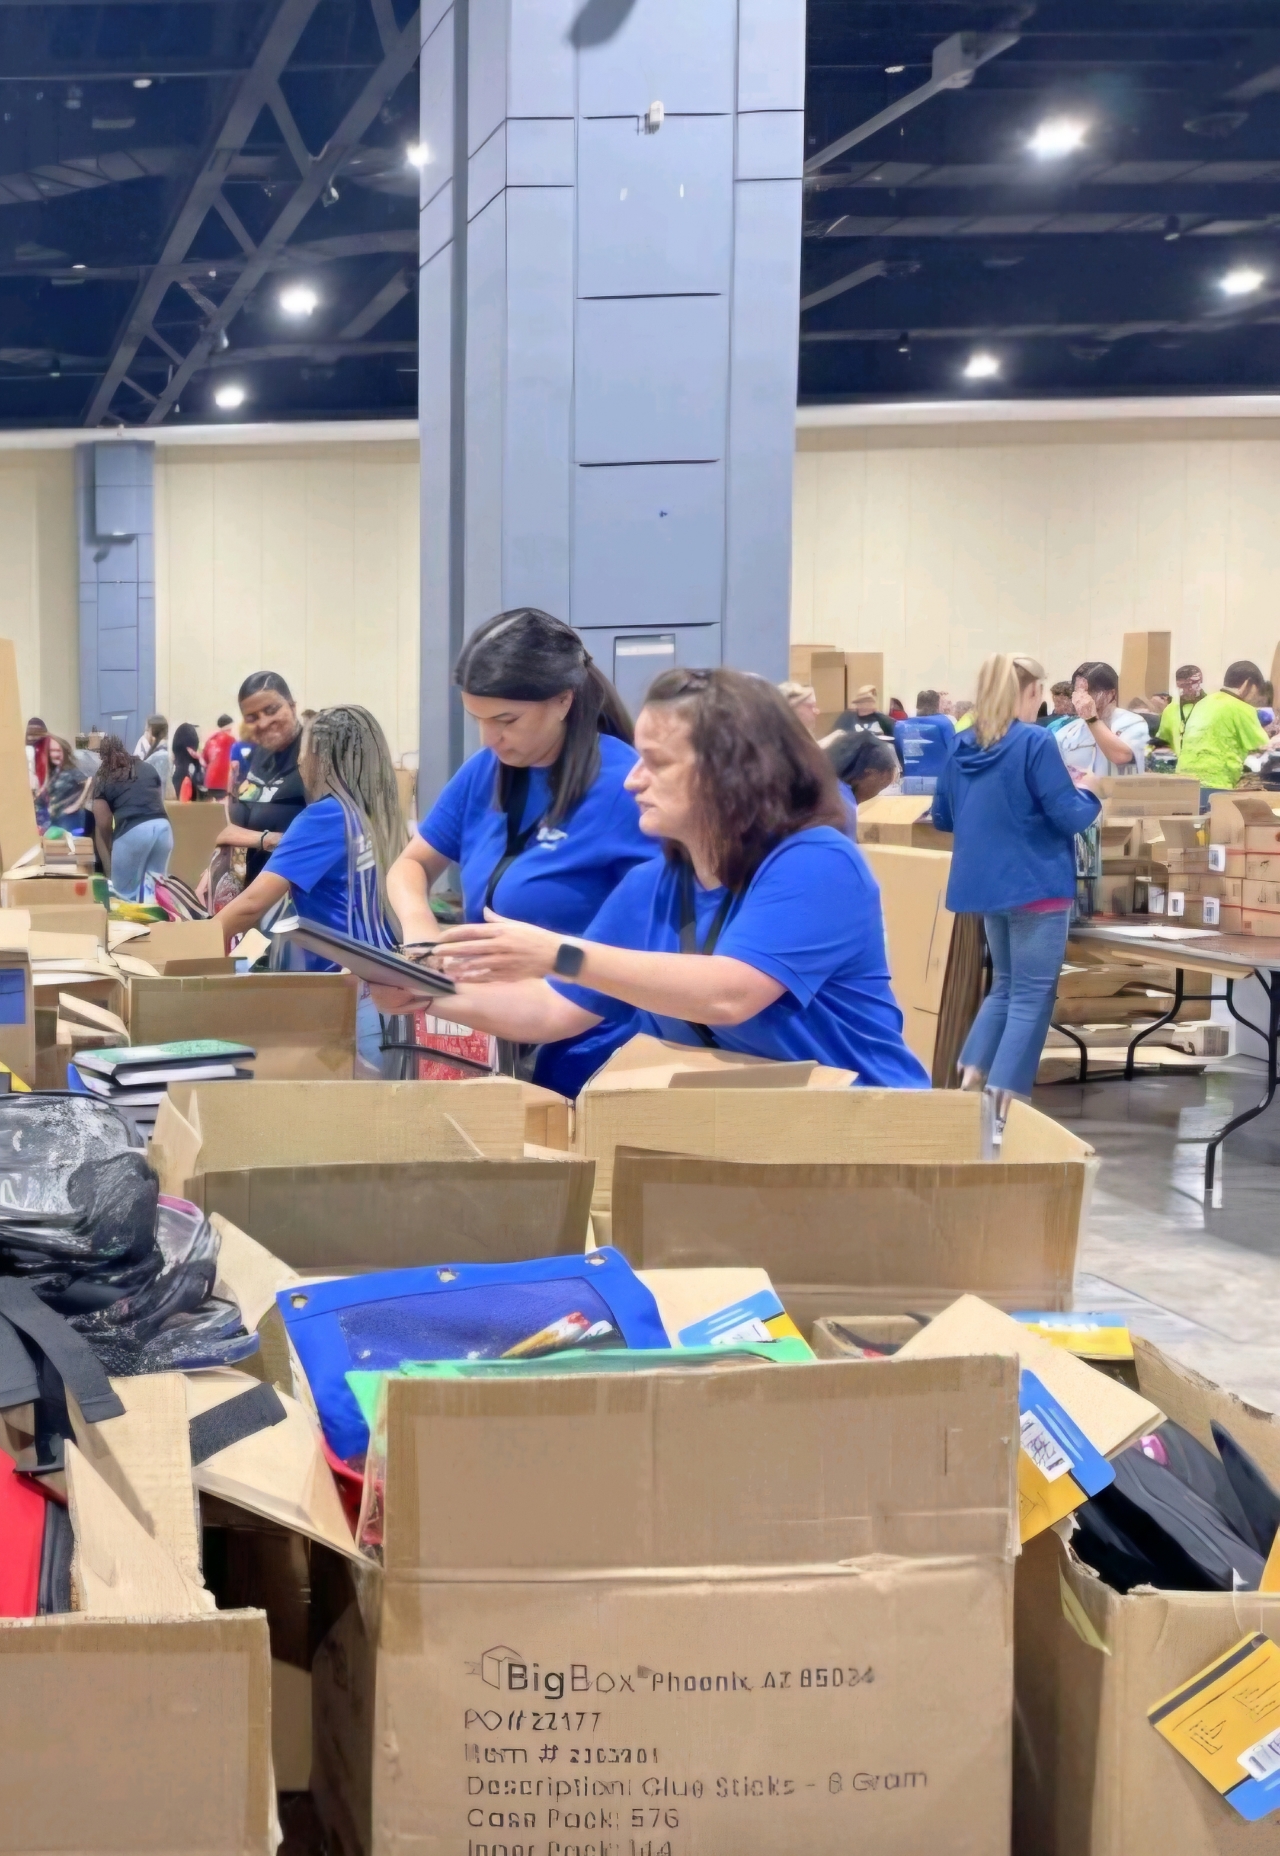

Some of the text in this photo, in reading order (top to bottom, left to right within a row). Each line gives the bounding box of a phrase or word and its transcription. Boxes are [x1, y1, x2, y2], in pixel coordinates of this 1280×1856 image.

[507, 1662, 635, 1700] BigBox
[465, 1743, 527, 1764] Item
[538, 1743, 558, 1763] #
[642, 1776, 704, 1798] Glue
[716, 1775, 795, 1798] Sticks
[852, 1771, 928, 1792] Gram
[467, 1808, 536, 1829] Case
[631, 1808, 680, 1829] 576
